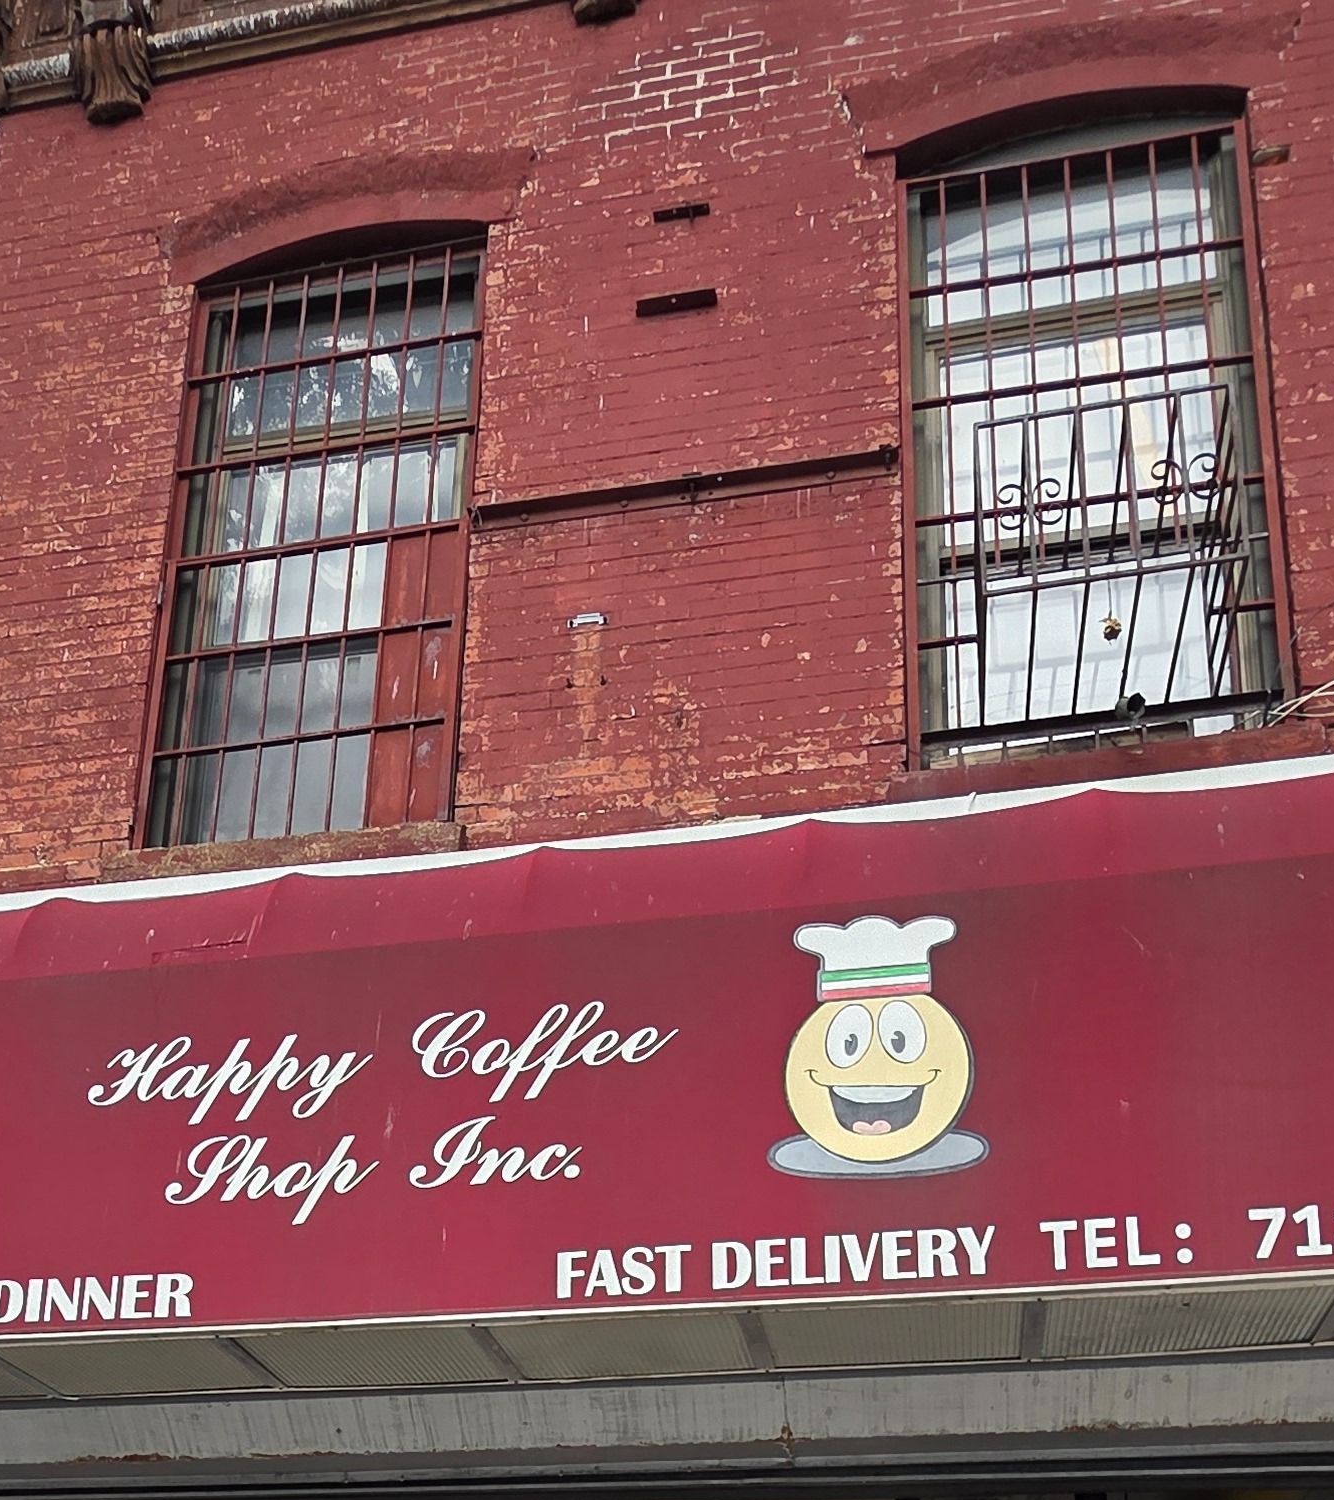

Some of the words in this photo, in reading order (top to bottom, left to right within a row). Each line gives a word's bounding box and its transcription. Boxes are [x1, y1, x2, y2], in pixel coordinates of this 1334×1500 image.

[88, 1034, 374, 1125] Happy
[412, 1001, 679, 1103] Coffee
[165, 1135, 380, 1225] Shop
[410, 1116, 582, 1188] Inc.
[556, 1244, 692, 1299] FAST
[712, 1225, 996, 1290] DELIVERY
[1040, 1216, 1193, 1271] TEL:
